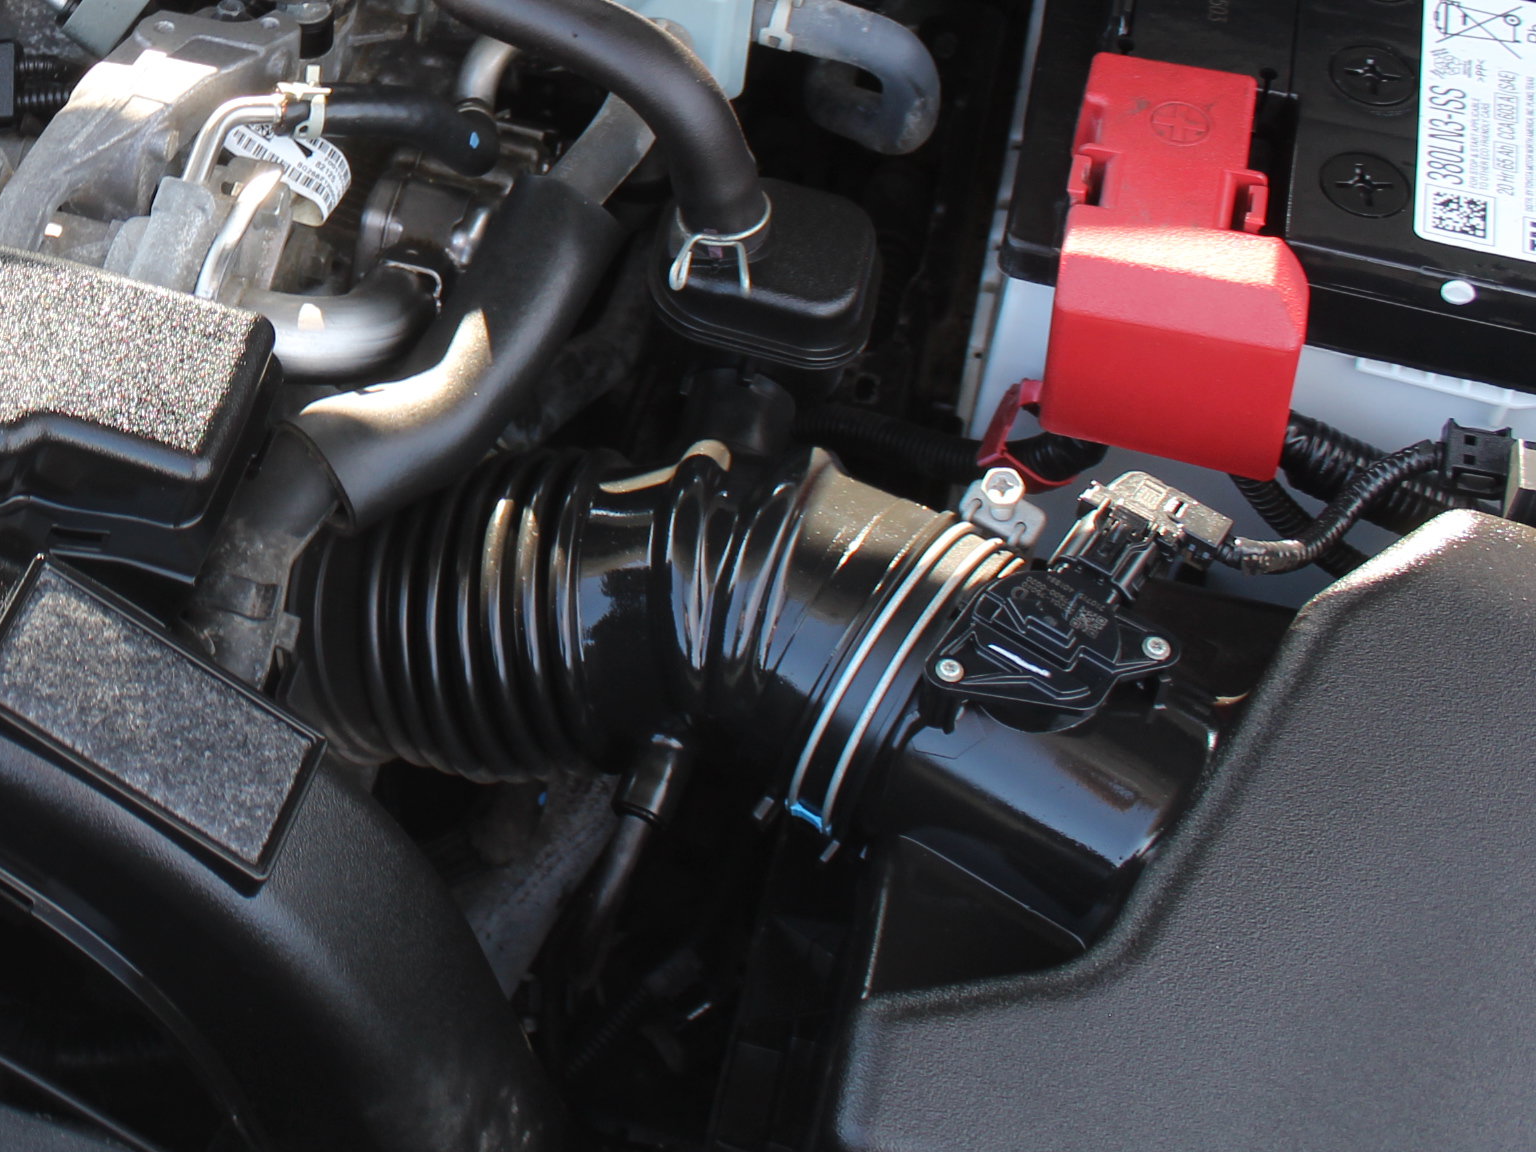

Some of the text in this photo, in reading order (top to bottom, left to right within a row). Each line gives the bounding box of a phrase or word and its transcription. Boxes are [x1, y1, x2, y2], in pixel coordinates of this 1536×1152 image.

[1497, 70, 1520, 94] (SAE)
[1497, 104, 1516, 120] 603
[1427, 85, 1466, 185] 380LN3-ISS
[1497, 122, 1515, 140] CCA
[1497, 145, 1515, 157] Ah
[1497, 158, 1515, 170] 65
[1497, 172, 1515, 183] Hr
[1497, 184, 1515, 196] 20
